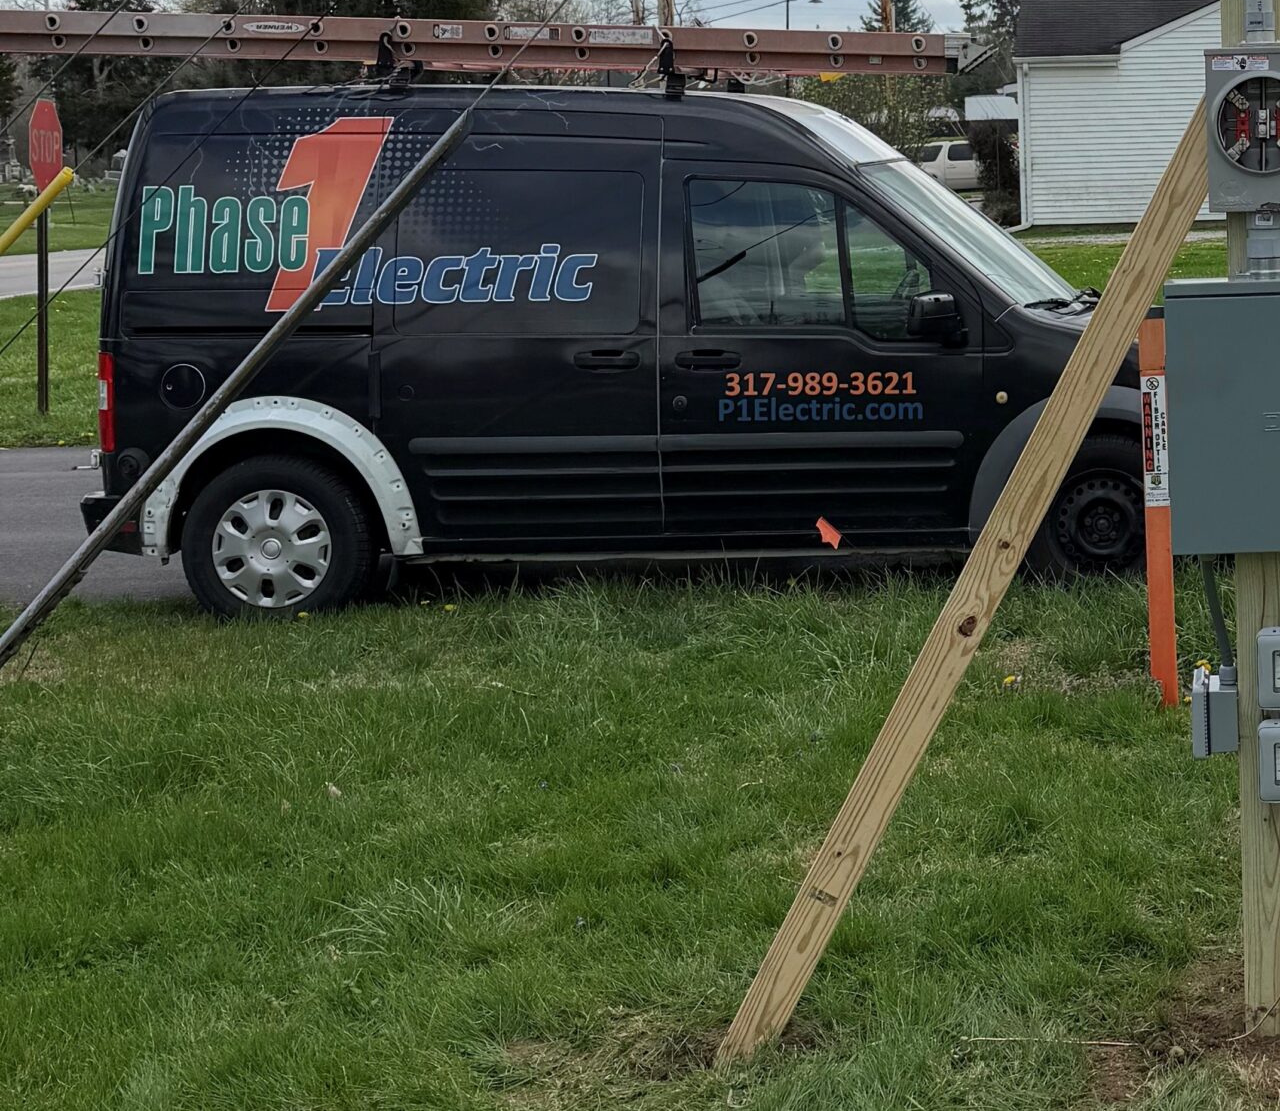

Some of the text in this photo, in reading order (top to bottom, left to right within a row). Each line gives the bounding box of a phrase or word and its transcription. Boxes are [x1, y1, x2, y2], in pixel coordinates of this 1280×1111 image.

[32, 129, 60, 163] STOP
[137, 116, 394, 312] Phase 1
[724, 371, 917, 397] 317-989-3621
[717, 397, 923, 422] P1Electric.com
[1143, 392, 1153, 471] WARNING
